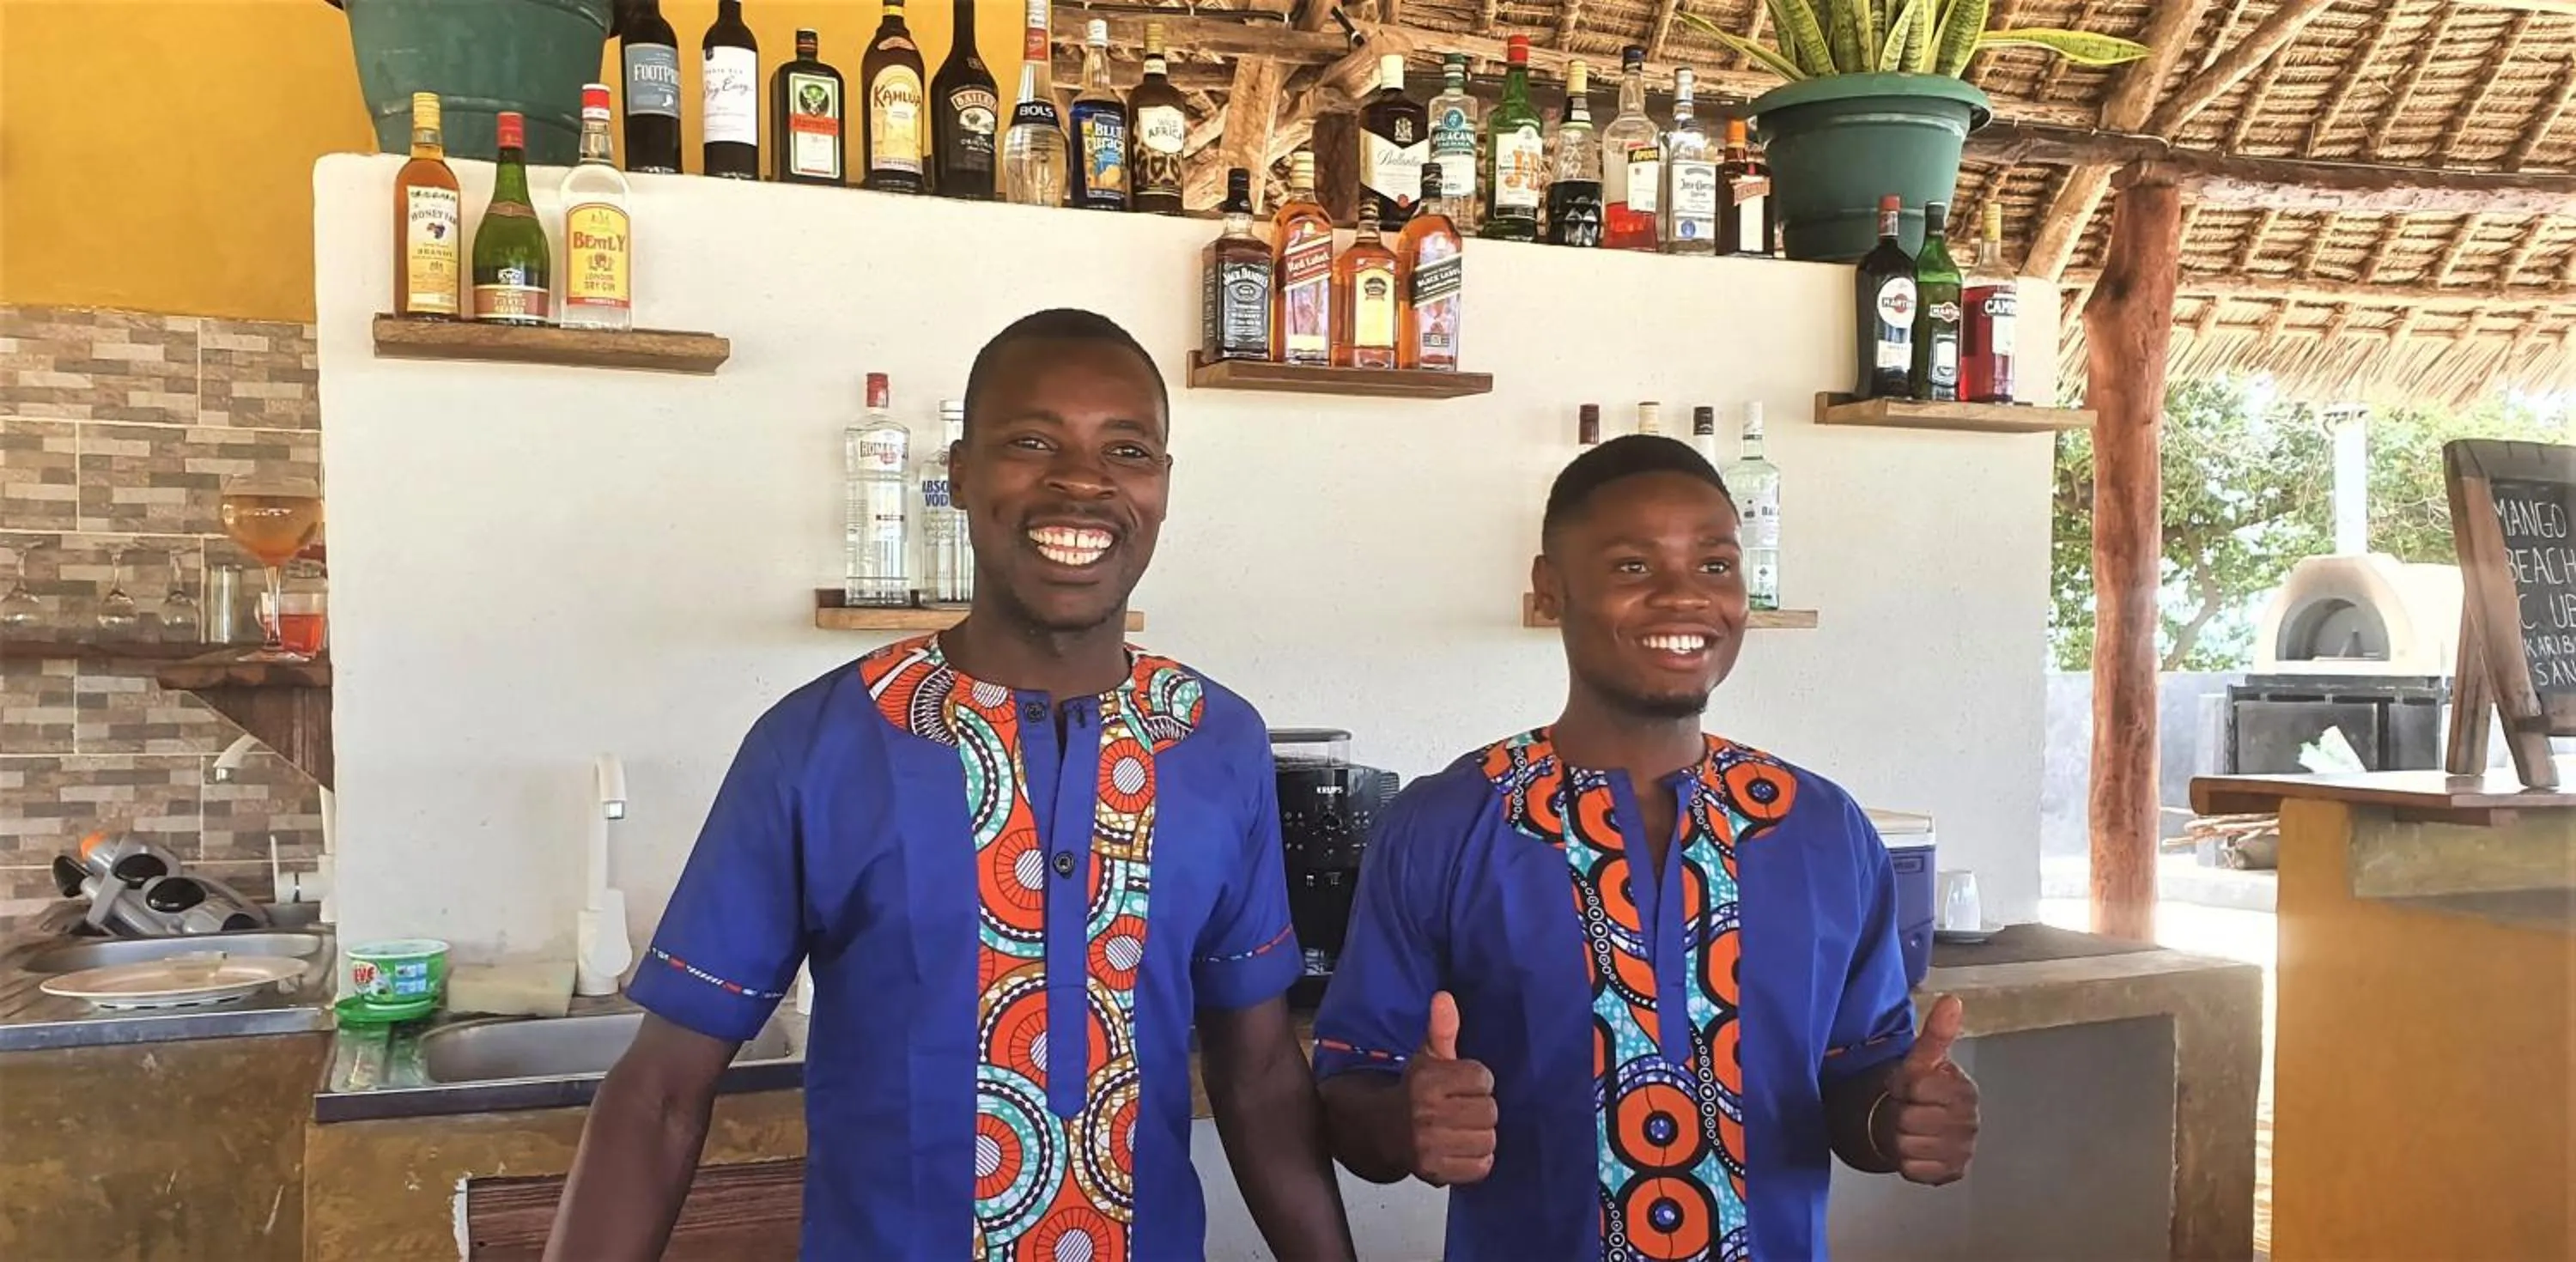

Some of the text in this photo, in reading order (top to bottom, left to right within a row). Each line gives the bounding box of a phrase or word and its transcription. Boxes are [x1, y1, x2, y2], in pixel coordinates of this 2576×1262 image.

[1019, 106, 1054, 118] BOLS
[2494, 498, 2567, 538] MANGO
[2504, 547, 2576, 585] BEACH
[1316, 786, 1344, 794] KRUPS
